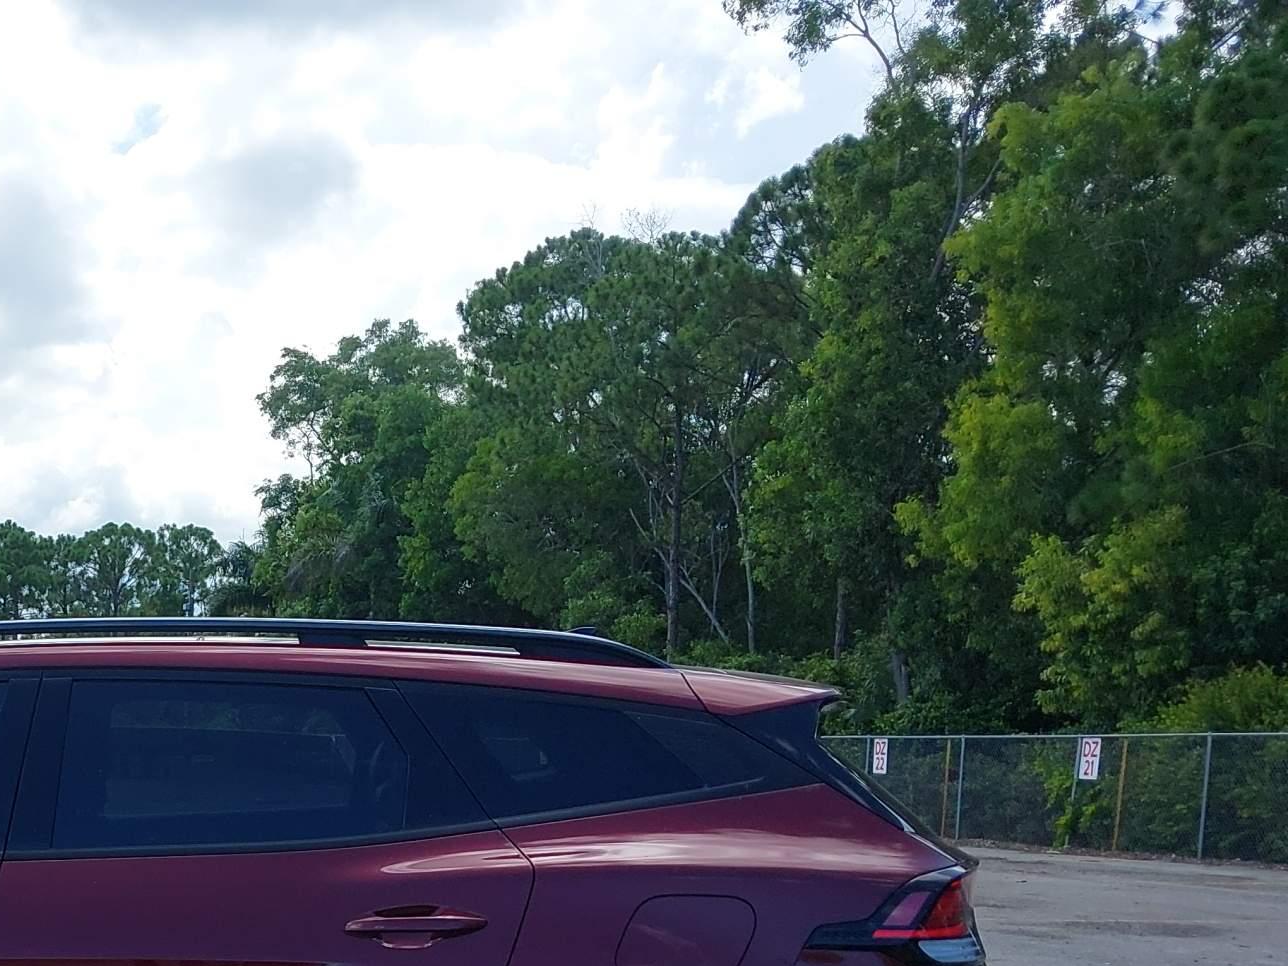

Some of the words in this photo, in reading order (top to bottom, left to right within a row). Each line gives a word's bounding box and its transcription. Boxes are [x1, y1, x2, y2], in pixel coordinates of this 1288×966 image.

[875, 741, 886, 756] DZ
[1083, 741, 1099, 757] DZ
[875, 756, 885, 771] 22
[1083, 759, 1094, 776] 21
